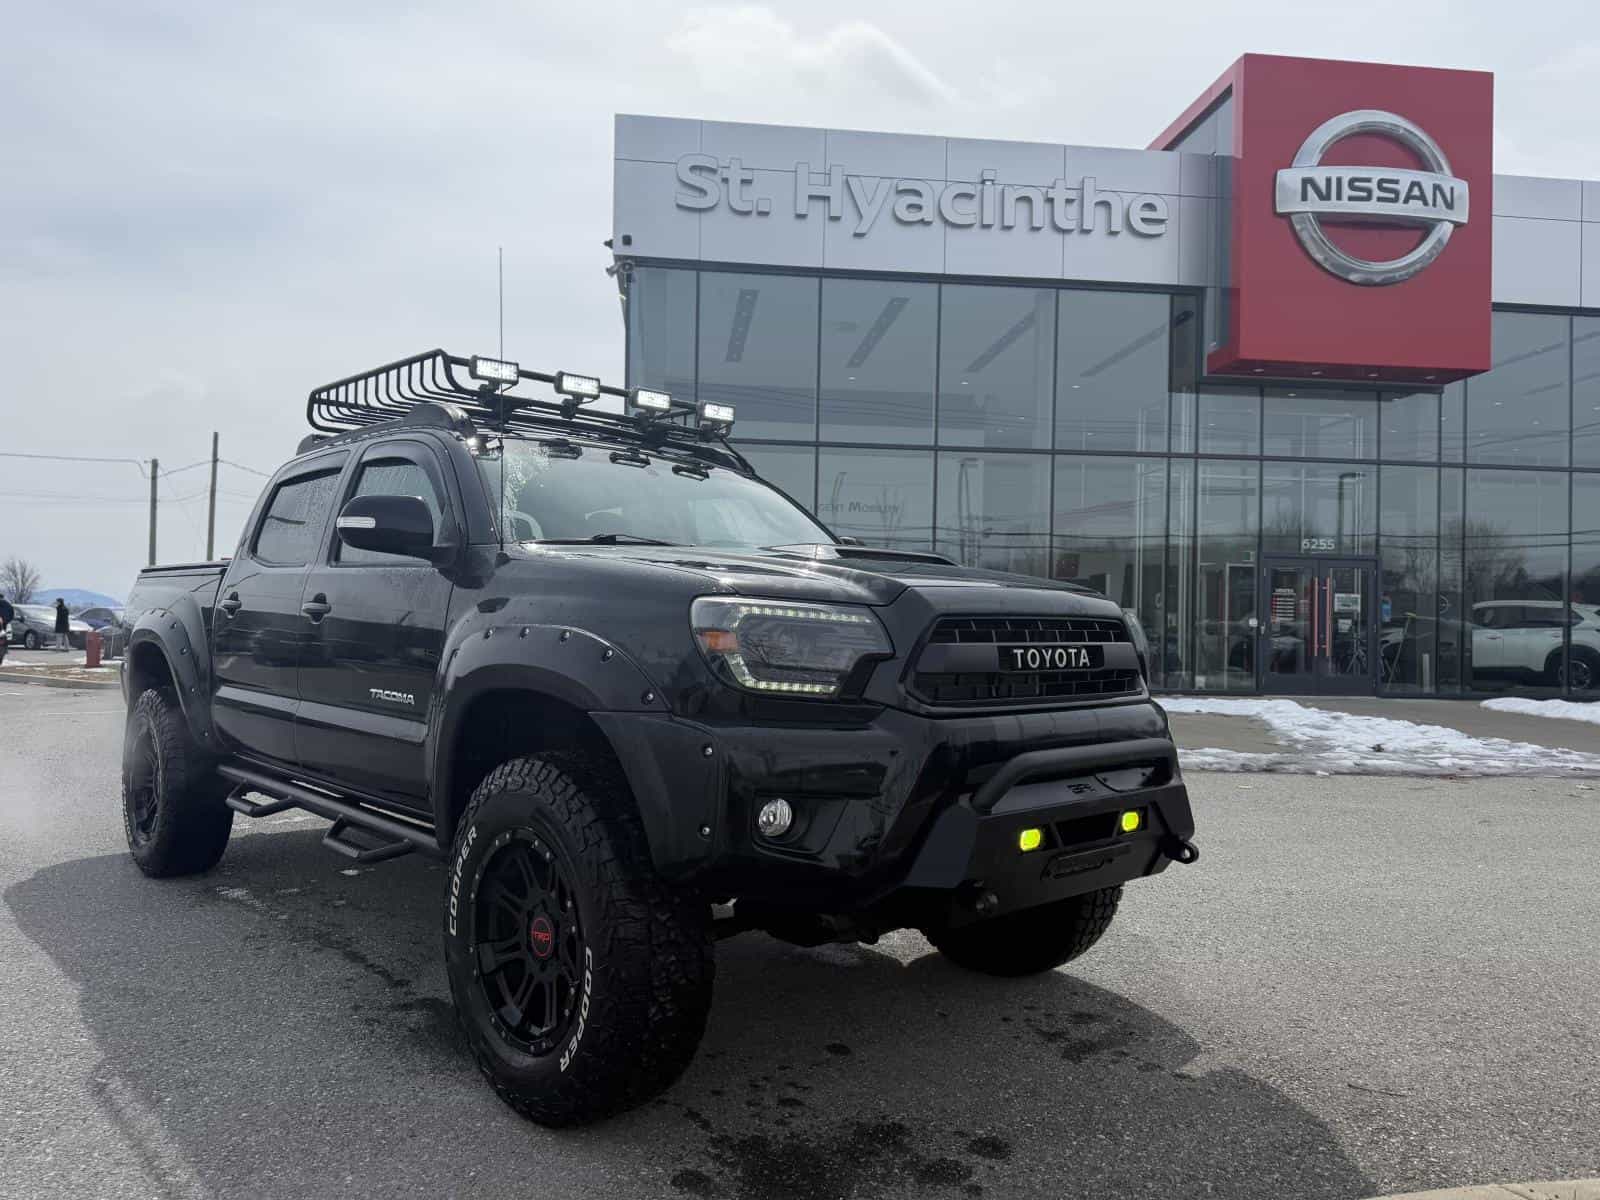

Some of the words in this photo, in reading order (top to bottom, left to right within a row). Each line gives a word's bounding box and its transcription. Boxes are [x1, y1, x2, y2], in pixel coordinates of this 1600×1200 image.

[675, 153, 771, 217] St.
[795, 160, 1169, 238] Hyacinthe
[1300, 175, 1455, 211] NISSAN
[1301, 538, 1336, 550] 6255
[1012, 648, 1091, 669] TOYOTA
[369, 688, 415, 705] TACOMA
[448, 825, 478, 937] COOPER
[559, 946, 593, 1072] COOPER
